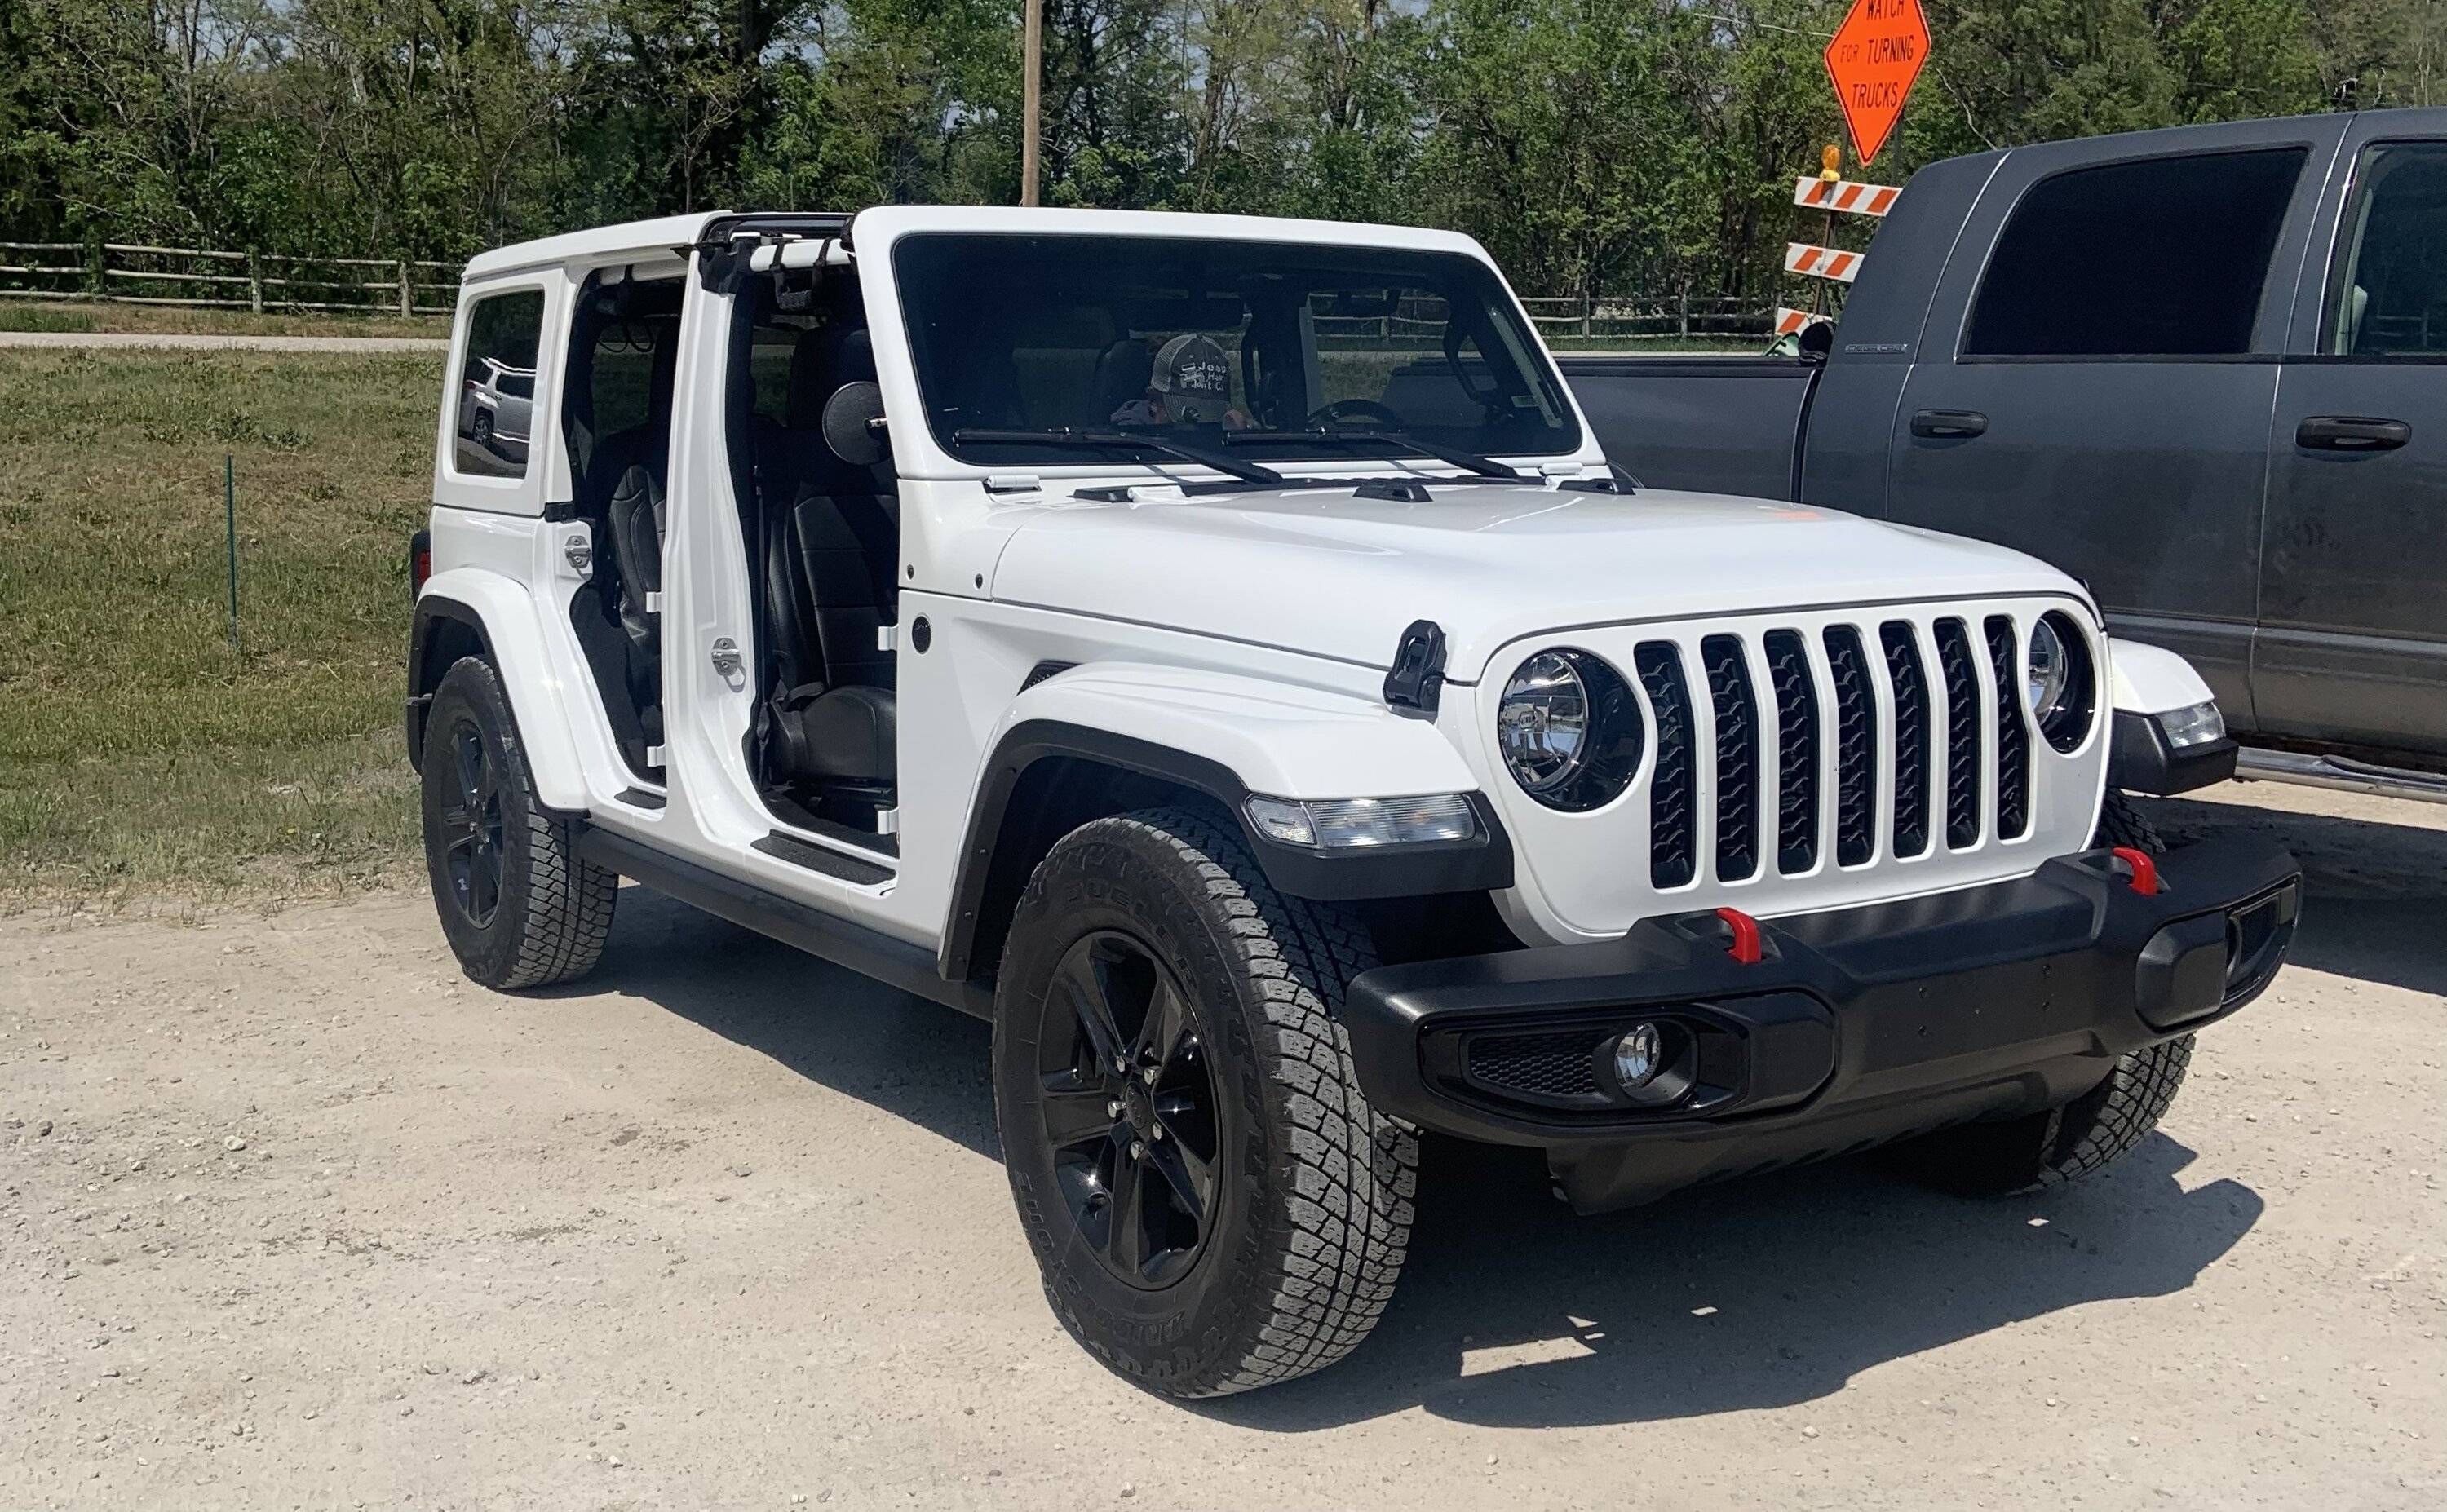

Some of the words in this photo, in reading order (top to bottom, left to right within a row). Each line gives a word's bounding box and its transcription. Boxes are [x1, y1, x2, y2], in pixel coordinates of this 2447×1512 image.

[1866, 0, 1904, 20] WATCH
[1840, 44, 1860, 63] FOR
[1867, 35, 1914, 64] TURNING
[1852, 82, 1899, 109] TRUCKS
